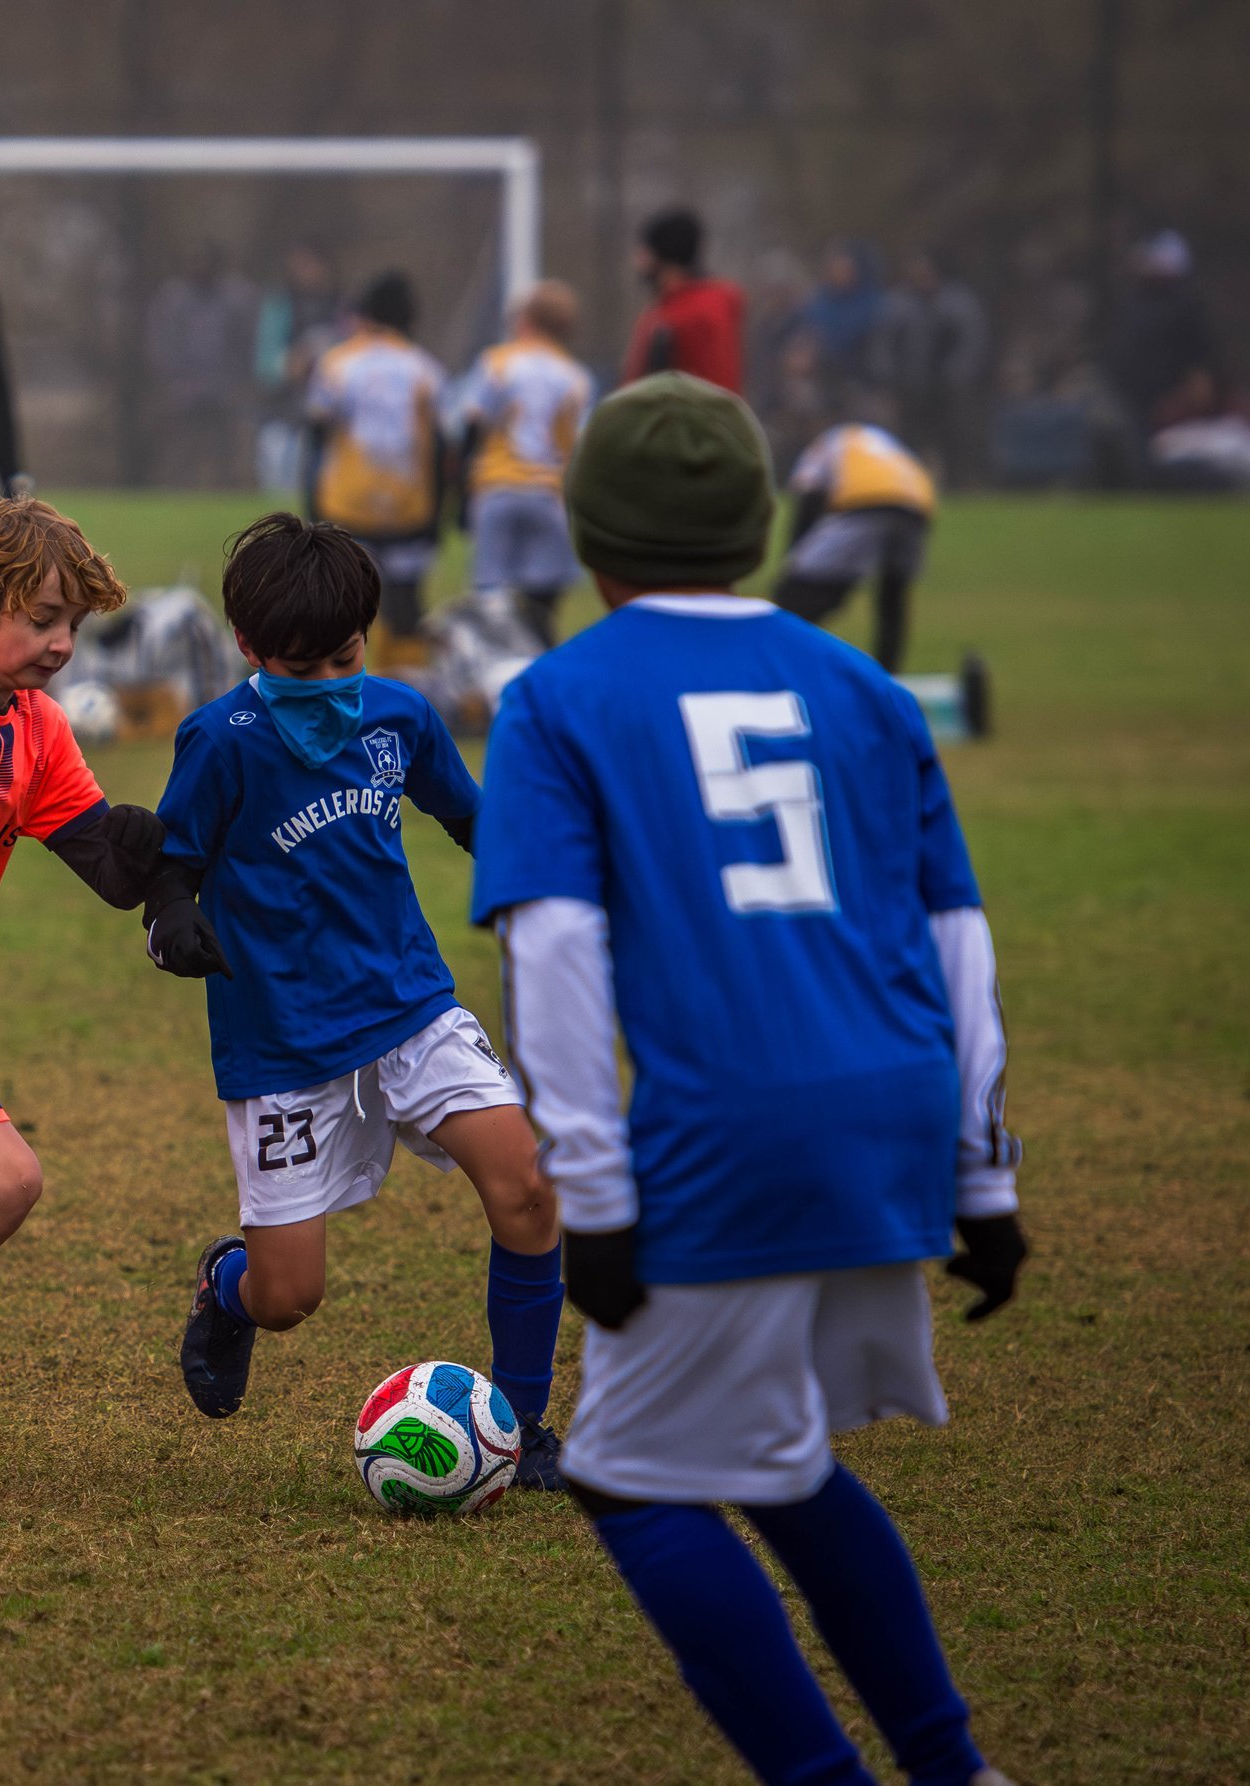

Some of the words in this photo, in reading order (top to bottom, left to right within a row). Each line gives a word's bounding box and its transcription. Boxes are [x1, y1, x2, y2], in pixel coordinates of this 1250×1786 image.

[271, 788, 384, 854] KINELEROS
[678, 690, 840, 915] 5
[258, 1108, 317, 1172] 23
